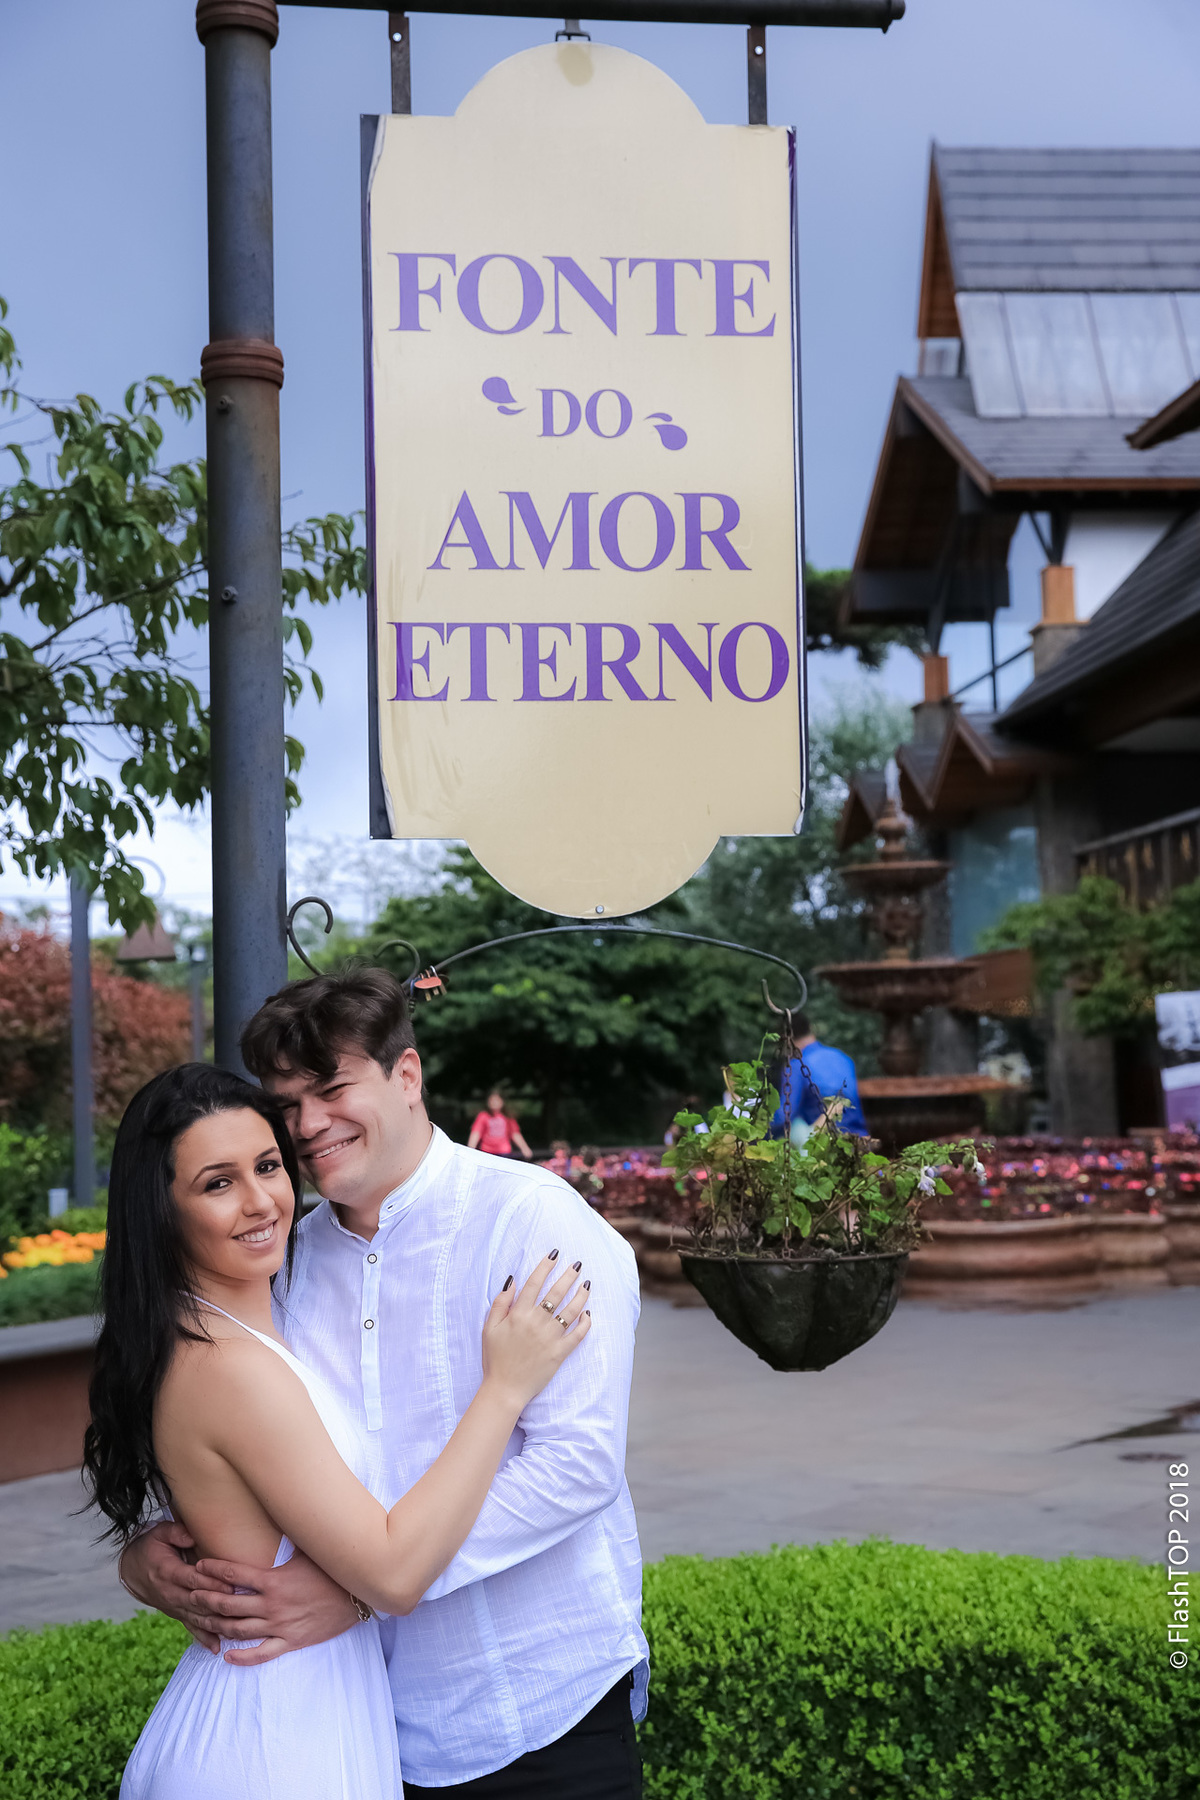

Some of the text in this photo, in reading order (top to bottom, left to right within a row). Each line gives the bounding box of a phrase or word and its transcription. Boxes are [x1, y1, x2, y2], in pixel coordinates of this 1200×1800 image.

[387, 252, 776, 337] FONTE
[536, 388, 633, 438] DO
[426, 490, 752, 572] AMOR
[386, 621, 790, 703] ETERNO
